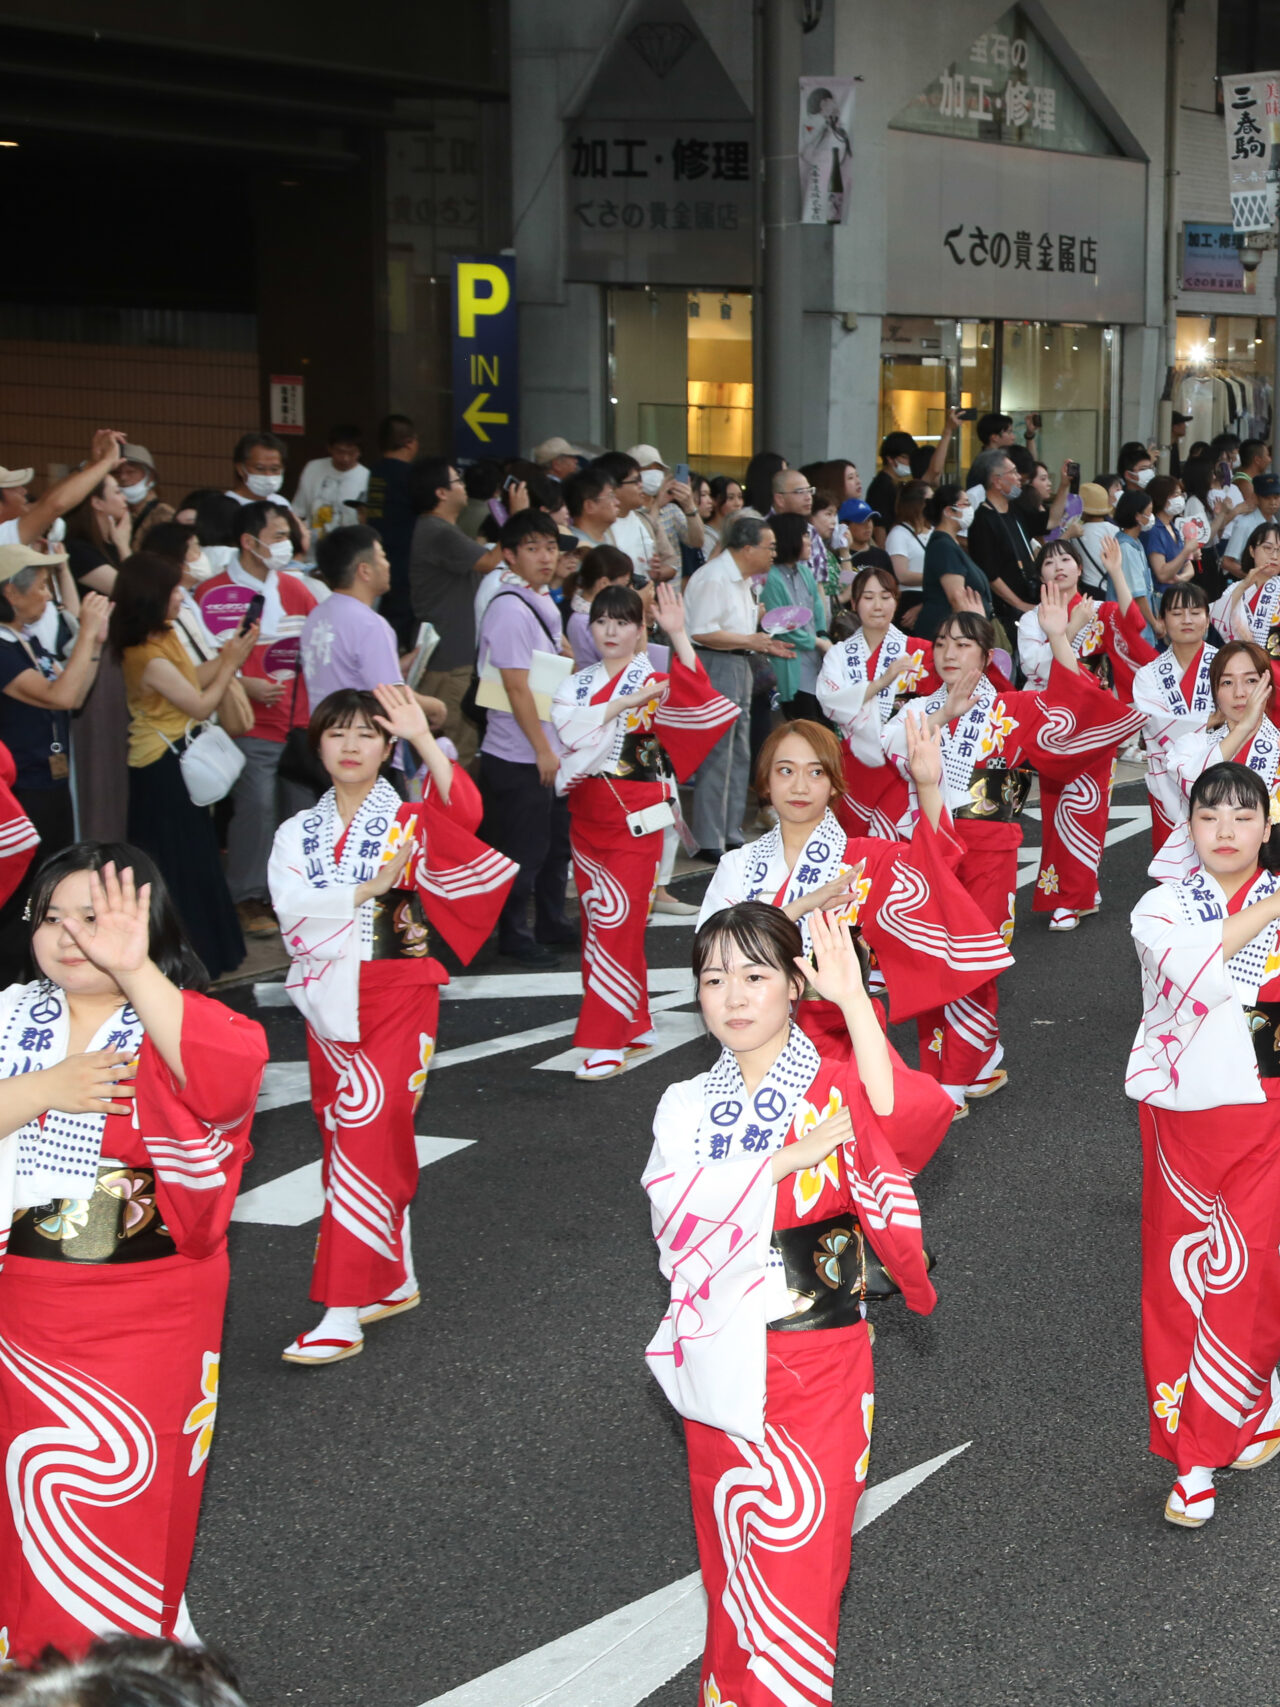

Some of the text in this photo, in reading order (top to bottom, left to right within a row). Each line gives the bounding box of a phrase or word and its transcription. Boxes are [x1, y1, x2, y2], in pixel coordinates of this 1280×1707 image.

[939, 68, 1056, 131] 加工・修理
[1231, 86, 1266, 160] 三春駒
[571, 136, 750, 181] 加工・修理
[574, 200, 739, 230] くさの貴金属店
[944, 224, 1098, 274] くさの貴金属店
[457, 263, 510, 338] P
[471, 354, 499, 386] IN
[1253, 594, 1272, 629] 郡山市
[847, 655, 863, 685] 郡山
[957, 709, 985, 757] 郡山市
[1191, 888, 1224, 922] 郡山
[740, 1123, 773, 1152] 郡
